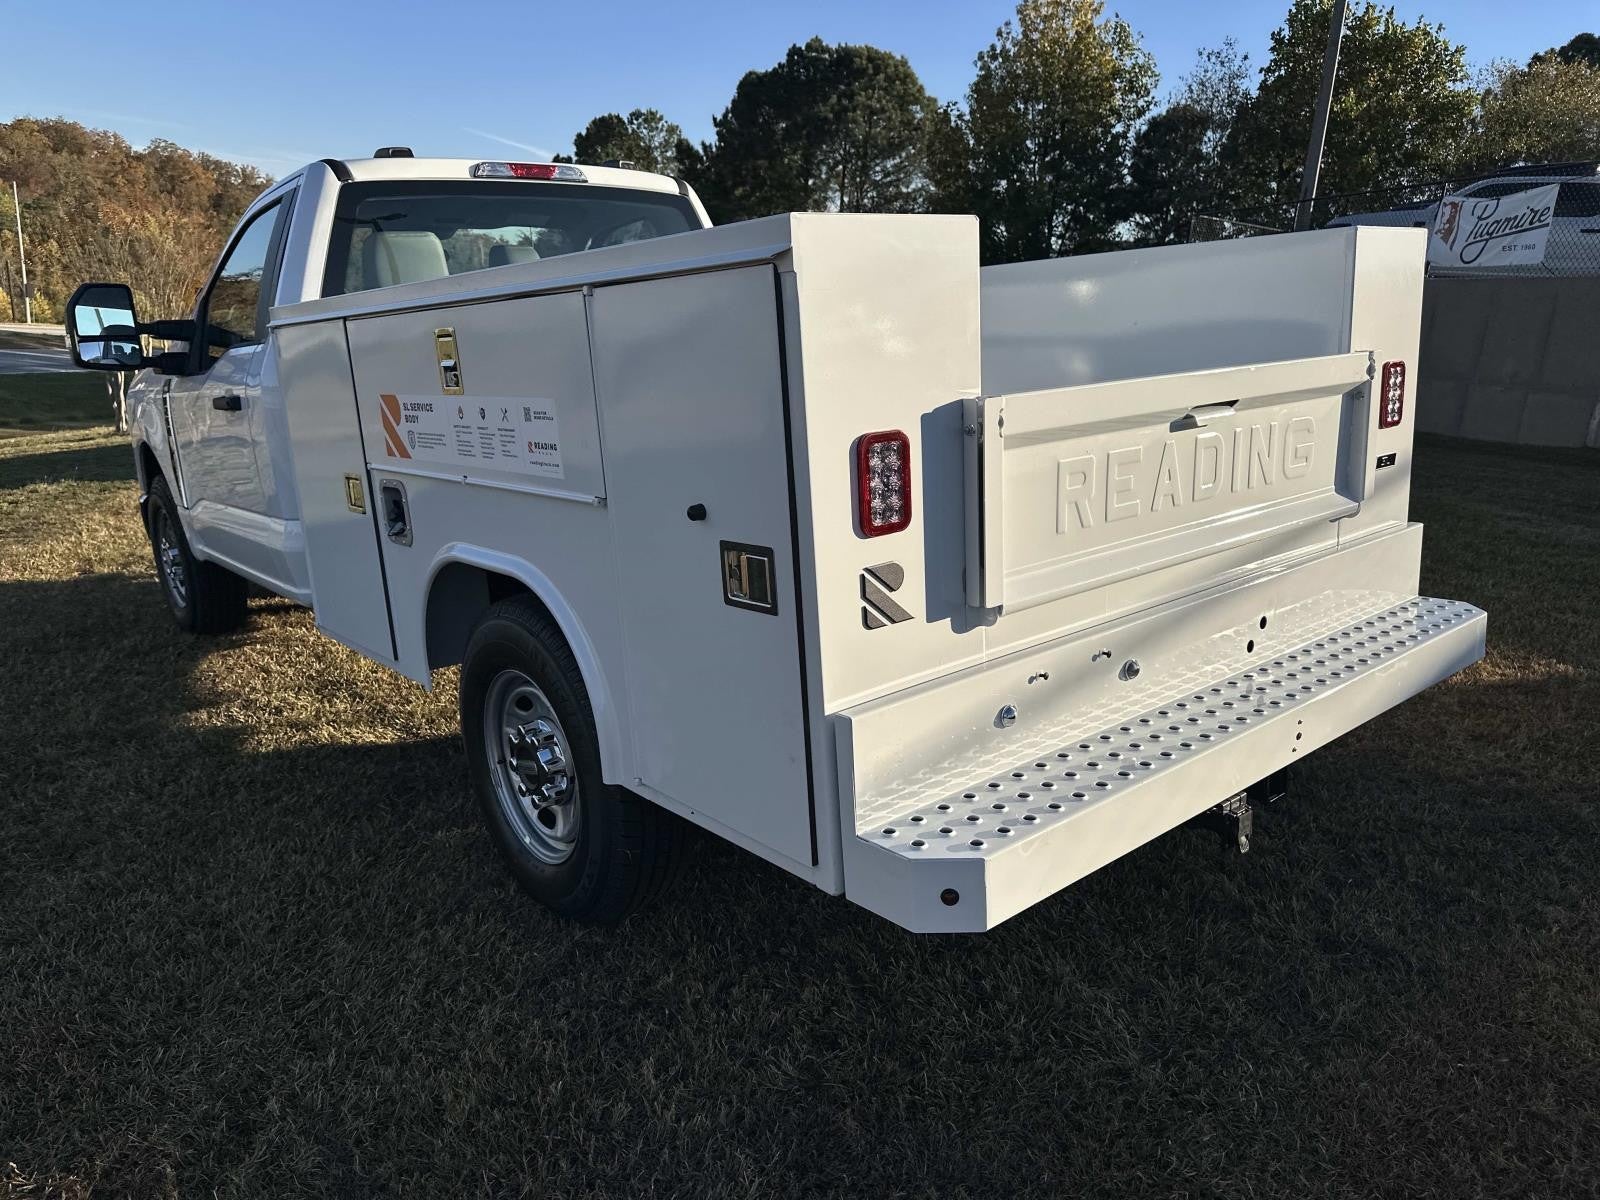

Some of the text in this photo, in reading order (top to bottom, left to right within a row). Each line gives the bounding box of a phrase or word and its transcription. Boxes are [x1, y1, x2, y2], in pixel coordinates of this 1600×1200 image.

[1460, 198, 1551, 264] Pugmire
[410, 402, 433, 413] SERVICE
[405, 414, 419, 424] BODY
[534, 442, 557, 452] READING
[1056, 416, 1316, 534] READING
